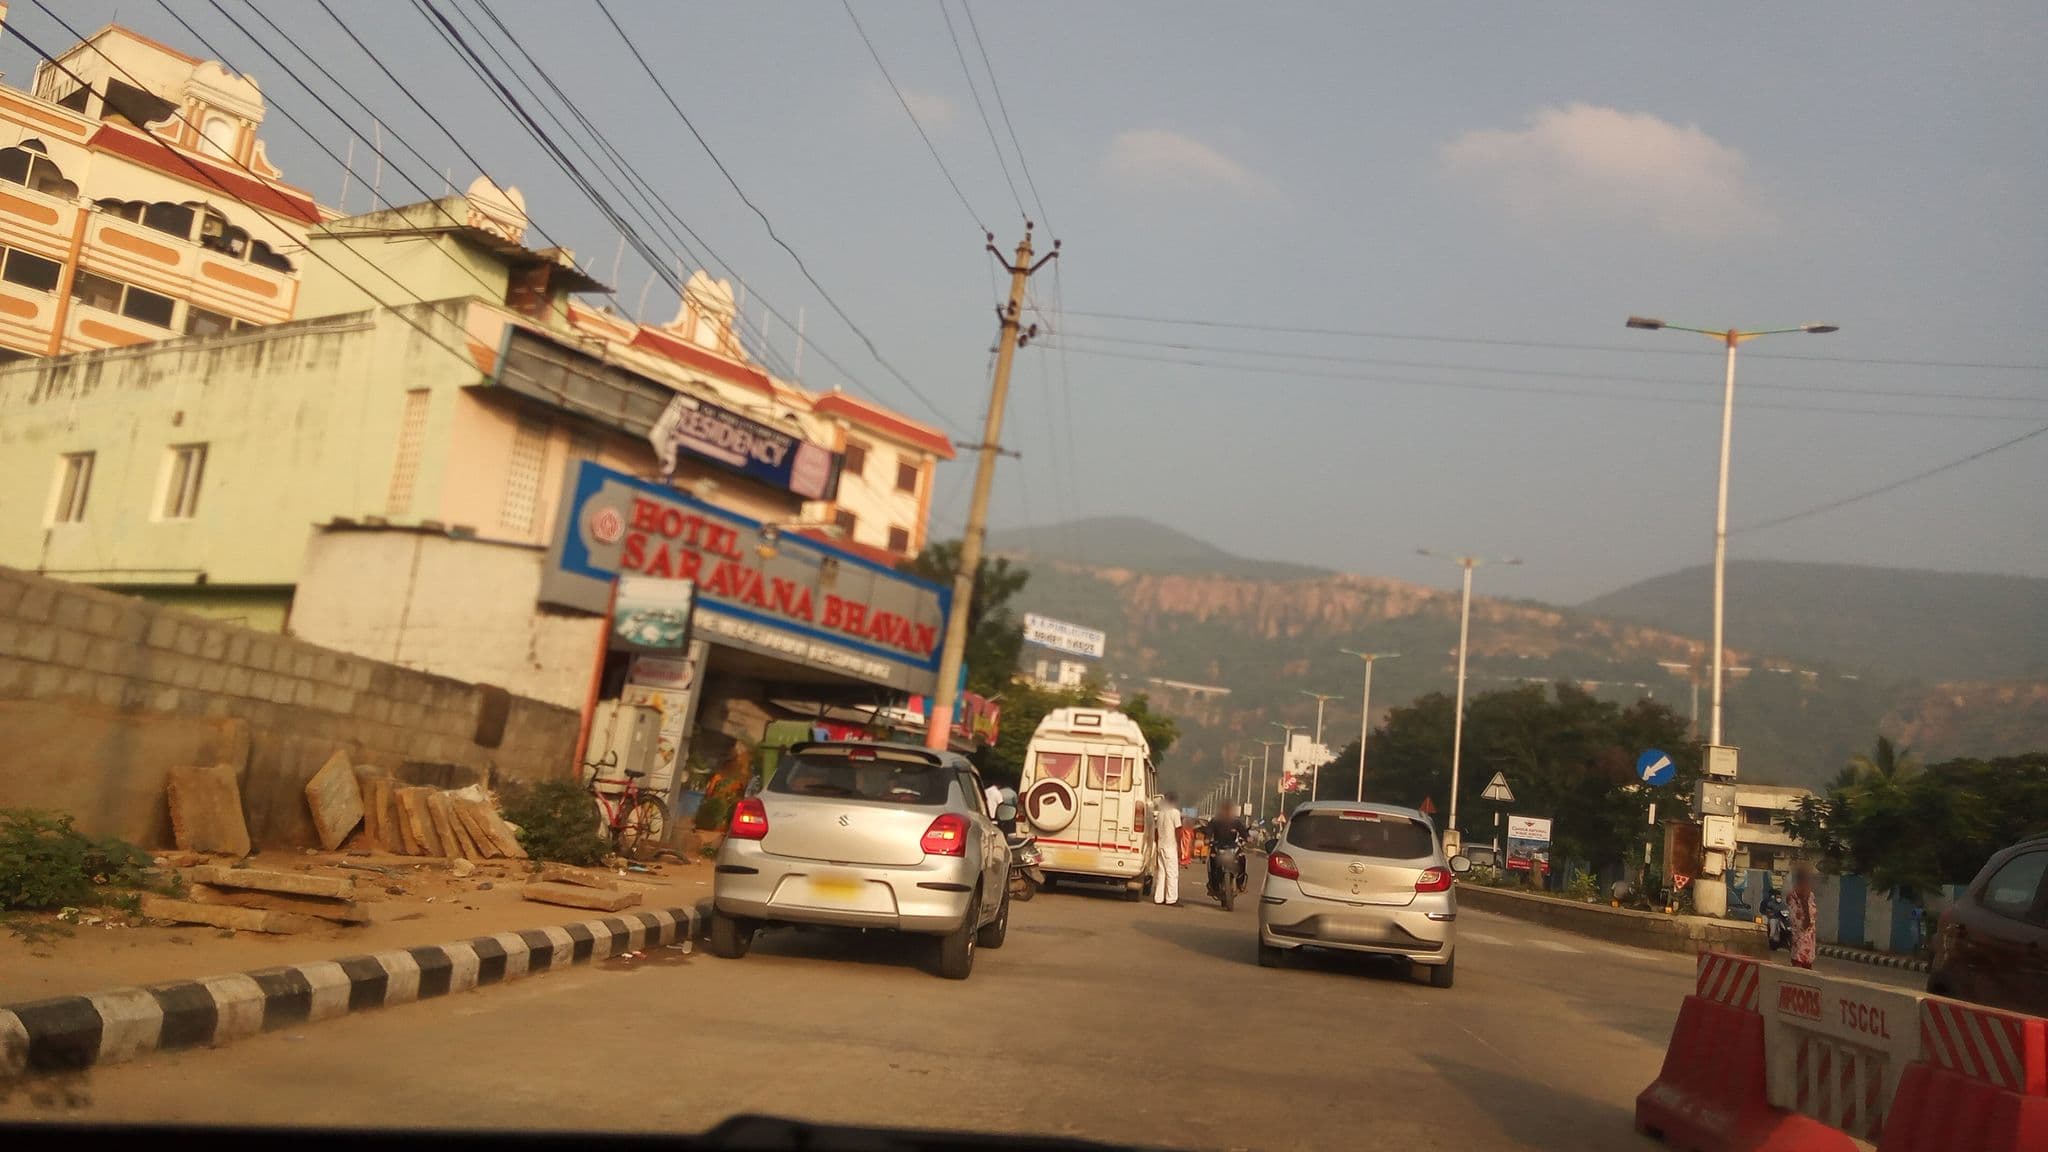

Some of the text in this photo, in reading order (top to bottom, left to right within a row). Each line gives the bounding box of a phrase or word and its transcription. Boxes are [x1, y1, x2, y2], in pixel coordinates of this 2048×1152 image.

[632, 497, 743, 562] HOTEL
[621, 532, 814, 622] SARAVANA
[821, 594, 937, 656] BHAVAN
[1839, 998, 1892, 1039] TSCCL
